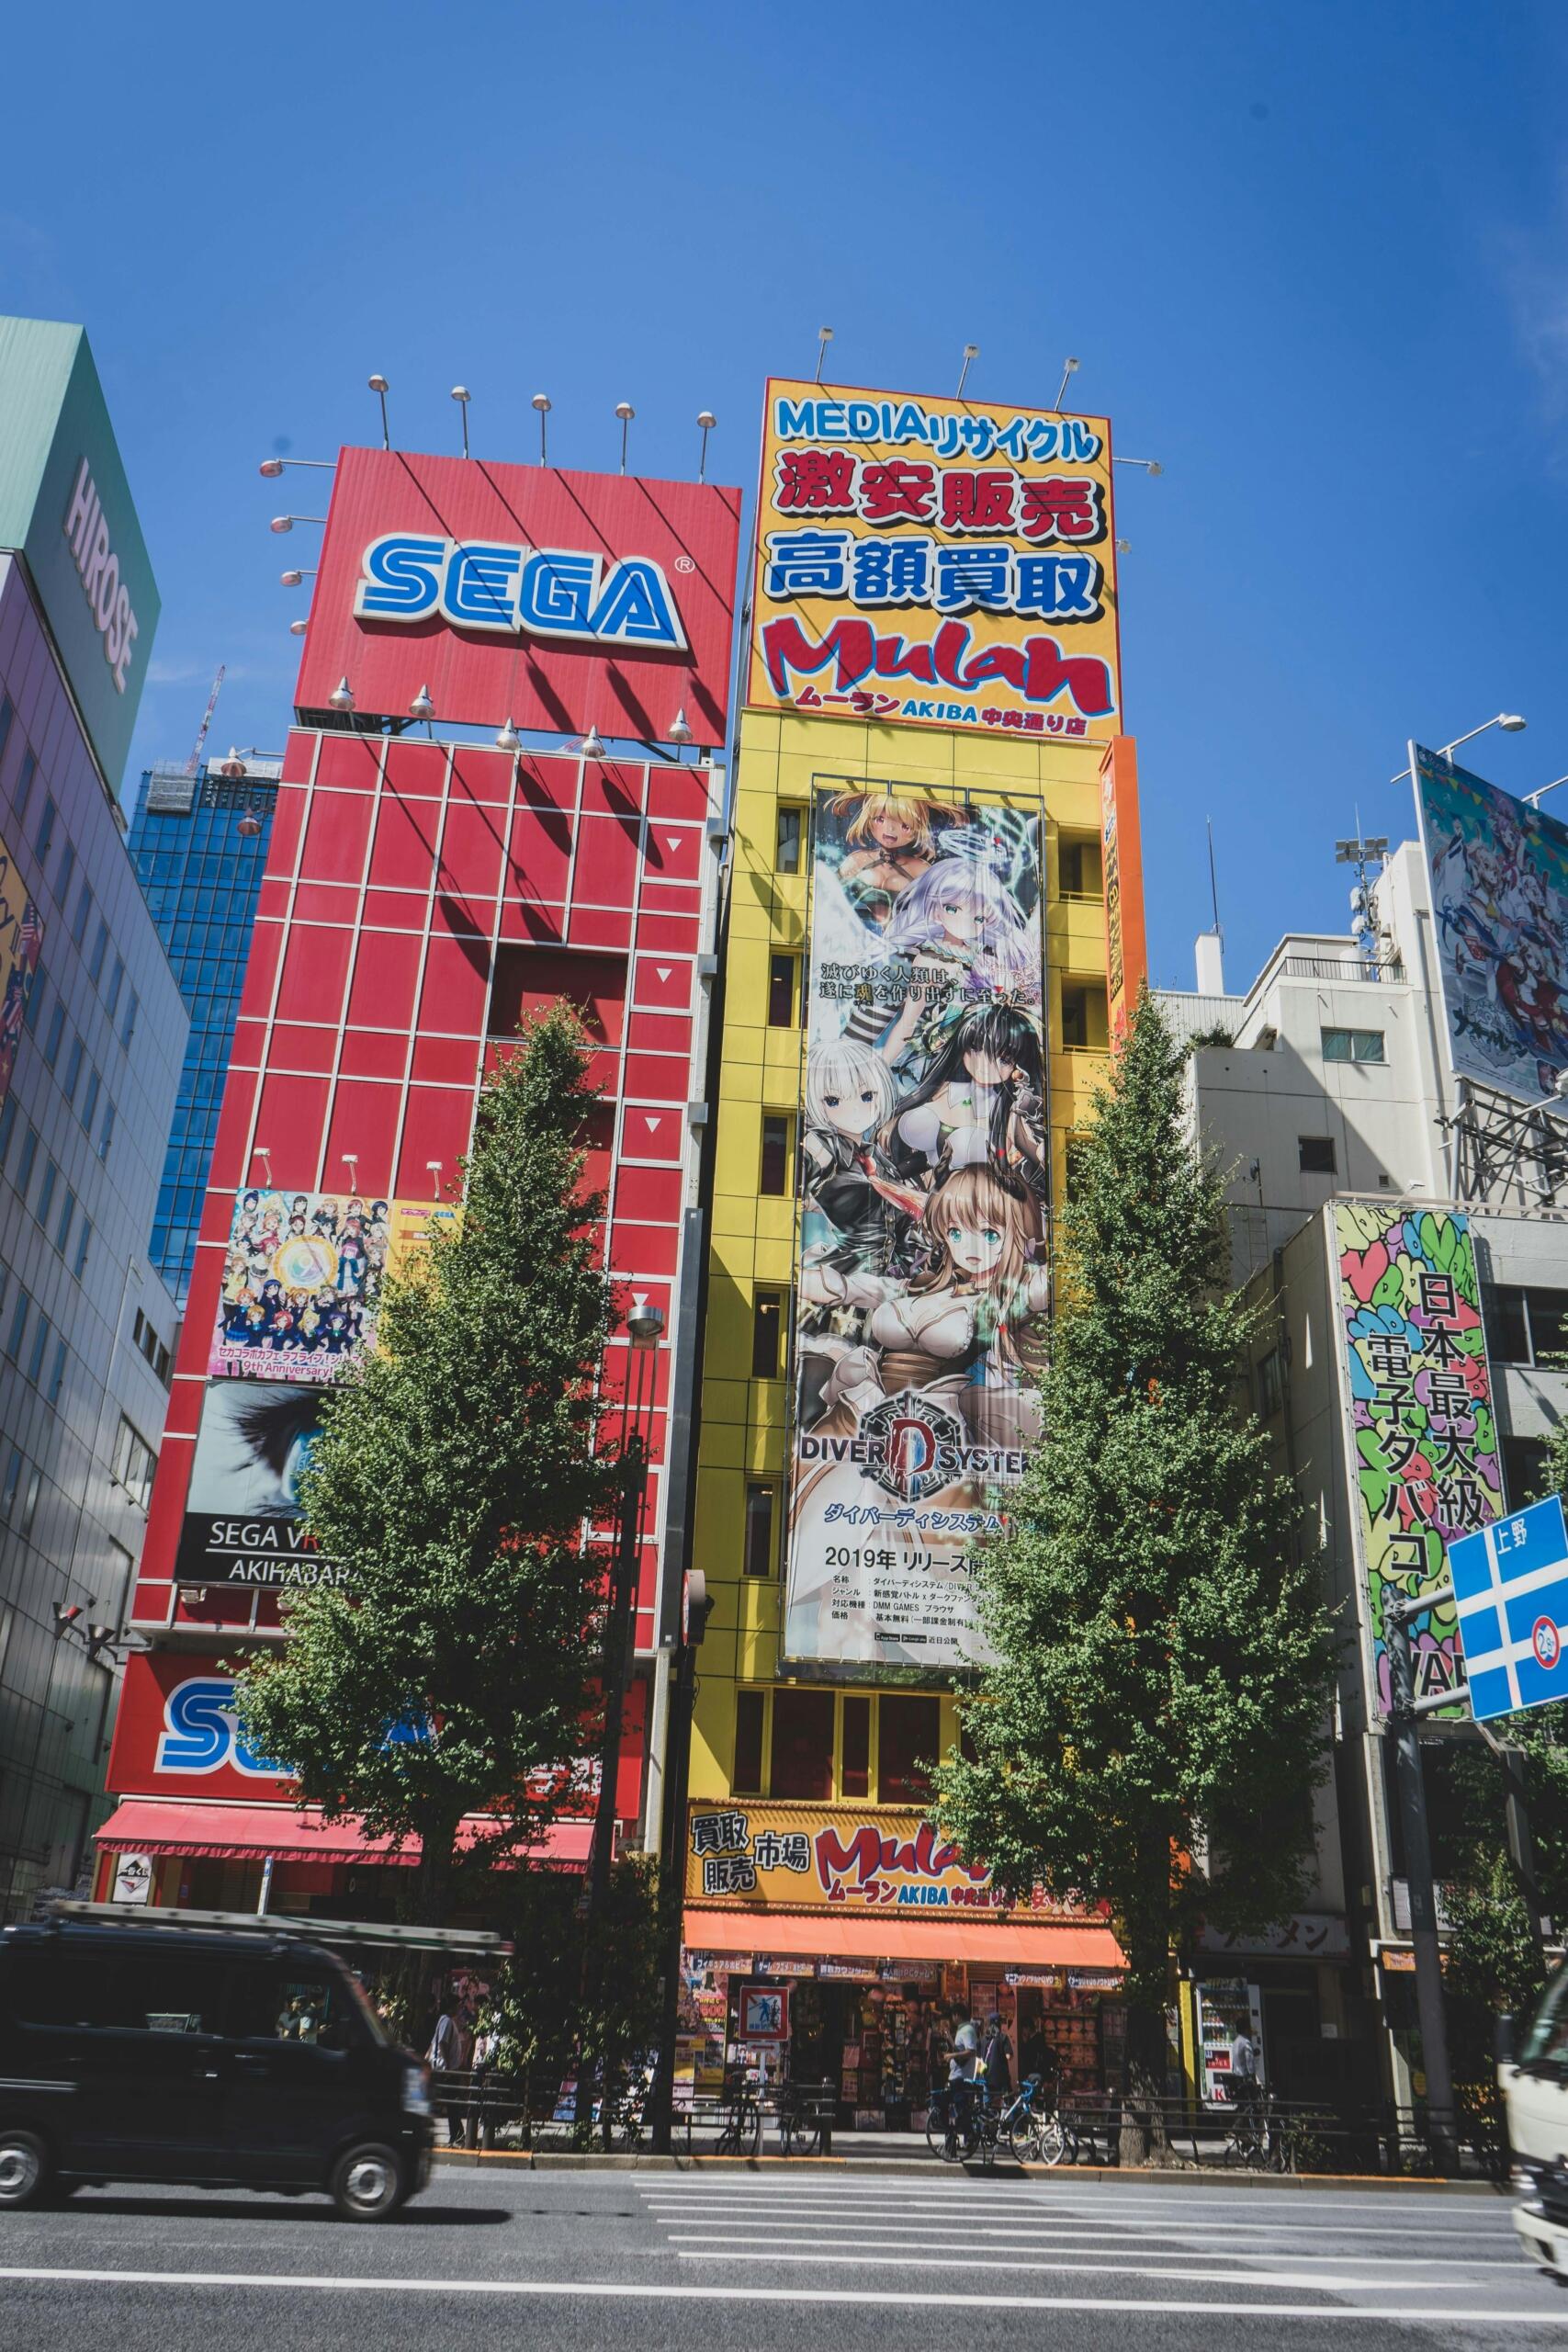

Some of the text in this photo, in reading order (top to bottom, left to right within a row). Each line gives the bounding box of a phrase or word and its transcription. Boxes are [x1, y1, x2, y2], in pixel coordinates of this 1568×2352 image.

[775, 398, 1105, 461] MEDIAリサイクル
[774, 447, 1100, 540] 激安販売
[64, 457, 139, 695] HIROSE
[764, 527, 1100, 618] 高額買取
[354, 532, 688, 651] SEGA
[761, 615, 1116, 718] Mulan
[795, 685, 1087, 736] ムーラン AKIBA 中央通り店
[821, 962, 958, 985] 滅びゆく人類は、
[819, 982, 1035, 1006] 遂に魂を作り出すに至った。
[243, 1361, 333, 1378] 9th Anniversary!
[1416, 1272, 1484, 1532] 日本最大級
[800, 1436, 887, 1464] DIVER
[1367, 1331, 1431, 1577] 電子タバコ
[824, 1503, 1004, 1533] ダイバーディシステム
[209, 1521, 320, 1550] SEGA VR
[1497, 1518, 1527, 1555] 上野
[229, 1559, 364, 1586] AKIHABAR
[825, 1546, 897, 1571] 2019年
[832, 1588, 861, 1596] ジャンル
[873, 1601, 891, 1611] DMM
[893, 1603, 919, 1612] GAMES
[831, 1611, 849, 1621] 価格
[928, 1636, 958, 1645] 近日公開
[691, 1811, 750, 1854] 買取
[754, 1830, 810, 1872] 市場
[704, 1856, 756, 1895] 販売
[827, 1878, 897, 1904] ムーラン
[897, 1884, 949, 1906] AKIBA
